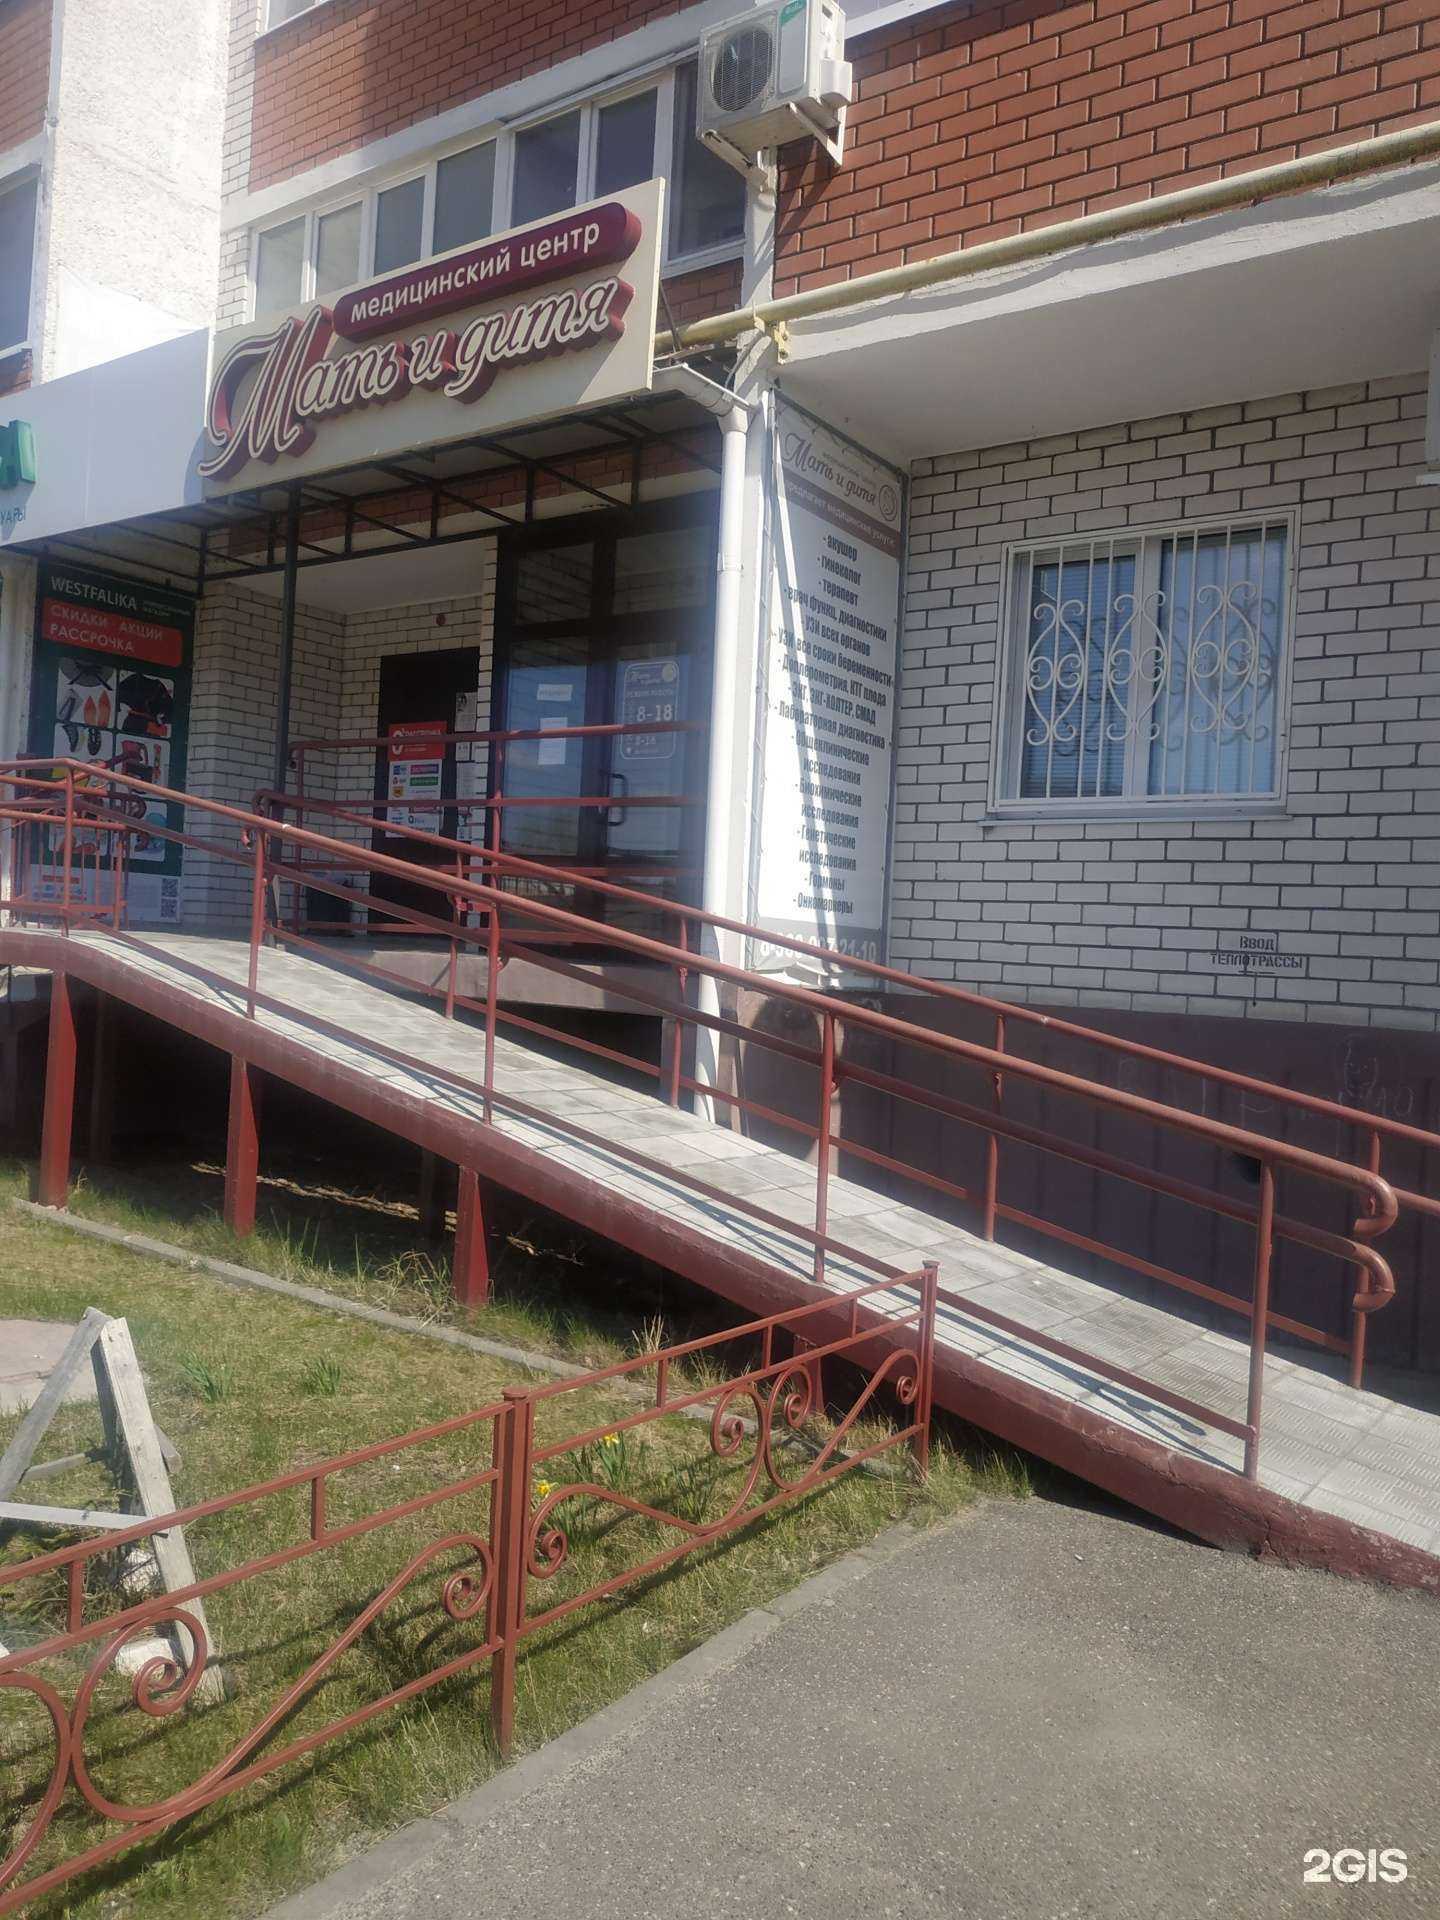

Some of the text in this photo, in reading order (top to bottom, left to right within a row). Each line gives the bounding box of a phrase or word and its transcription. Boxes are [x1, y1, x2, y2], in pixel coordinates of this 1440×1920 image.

[351, 221, 601, 324] медицинский центр
[197, 276, 620, 477] Мать и дитя
[782, 432, 834, 481] Мать
[835, 472, 844, 488] и
[843, 479, 877, 506] дитя
[827, 534, 858, 562] акушер
[821, 555, 861, 586] гинеколог
[50, 576, 138, 611] WESTFALIKA
[822, 579, 859, 607] терапевт
[50, 604, 164, 641] СКИДКИ АКЦИИ
[805, 614, 871, 657] УЗИ всех органов
[50, 623, 135, 653] РАССРОЧКА
[812, 644, 837, 666] сроки
[637, 704, 672, 721] 8-18
[803, 758, 861, 786] исследования
[800, 777, 862, 808] Биохимические
[801, 803, 859, 829] исследования
[801, 825, 856, 850] Генетические
[799, 849, 857, 872] исследования
[808, 871, 845, 891] Гормоны
[797, 892, 854, 914] Онкомаркеры
[1239, 935, 1275, 951] ВВОД
[1210, 953, 1303, 969] ТЕПЛОТРАССЫ
